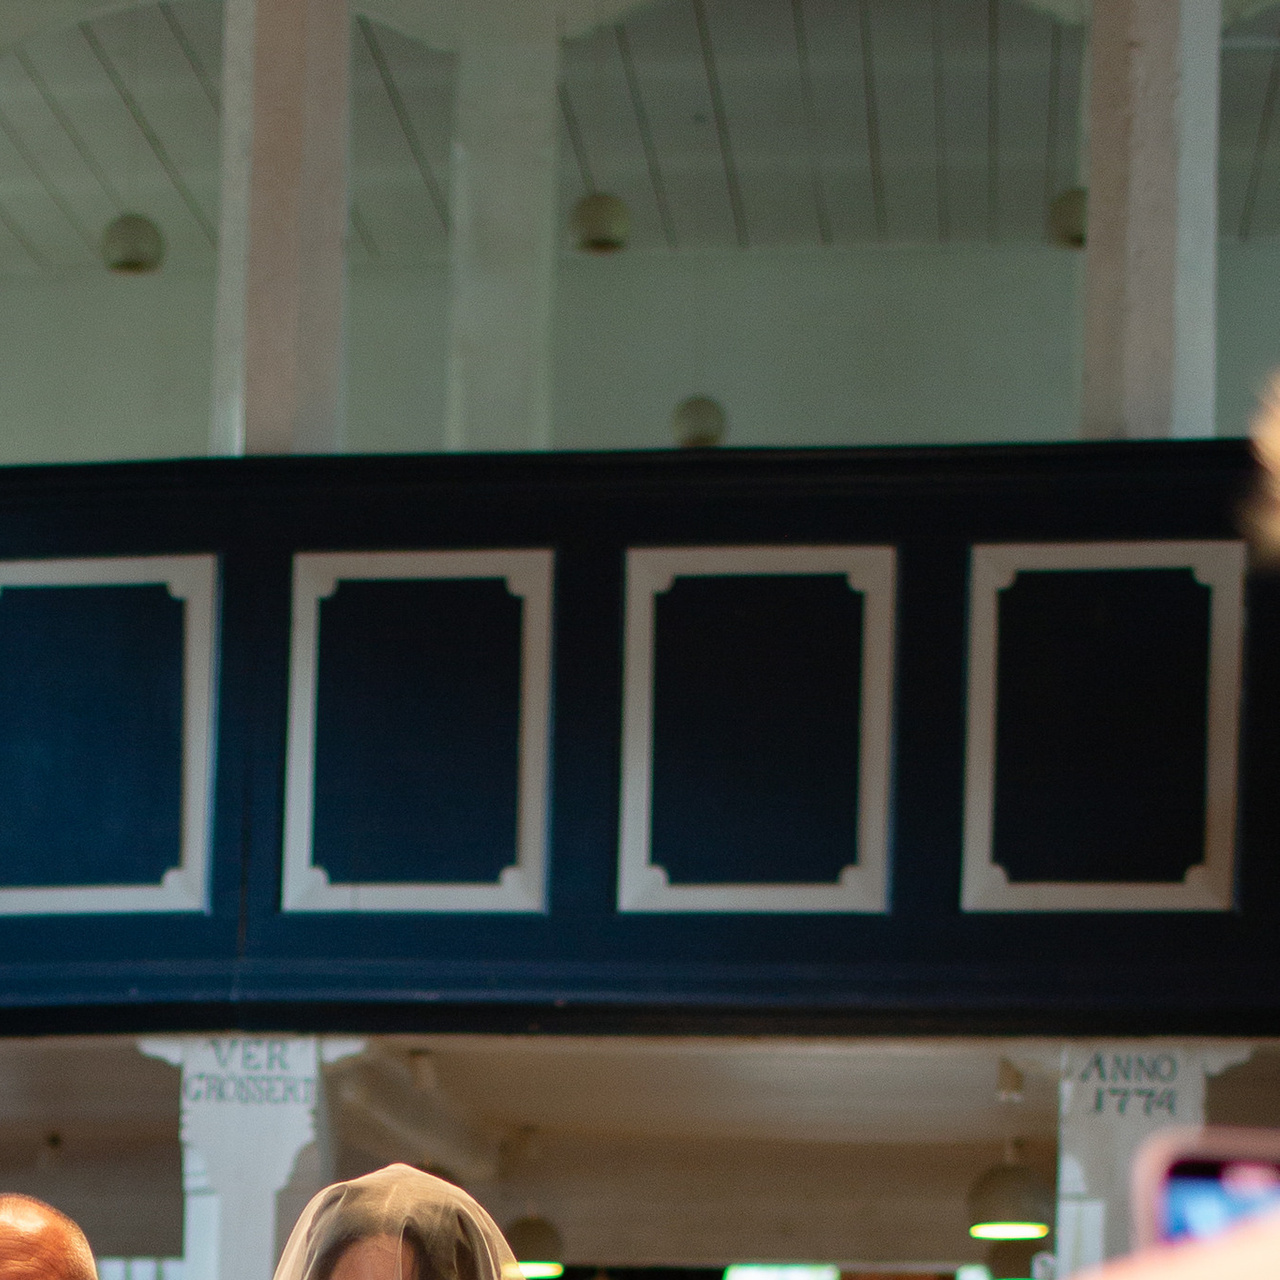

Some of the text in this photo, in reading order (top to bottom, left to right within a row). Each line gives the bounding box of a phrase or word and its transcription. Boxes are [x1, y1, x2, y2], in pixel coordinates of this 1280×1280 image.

[210, 1039, 290, 1070] VER
[1077, 1051, 1178, 1083] ANNO
[1095, 1088, 1177, 1117] 1774
